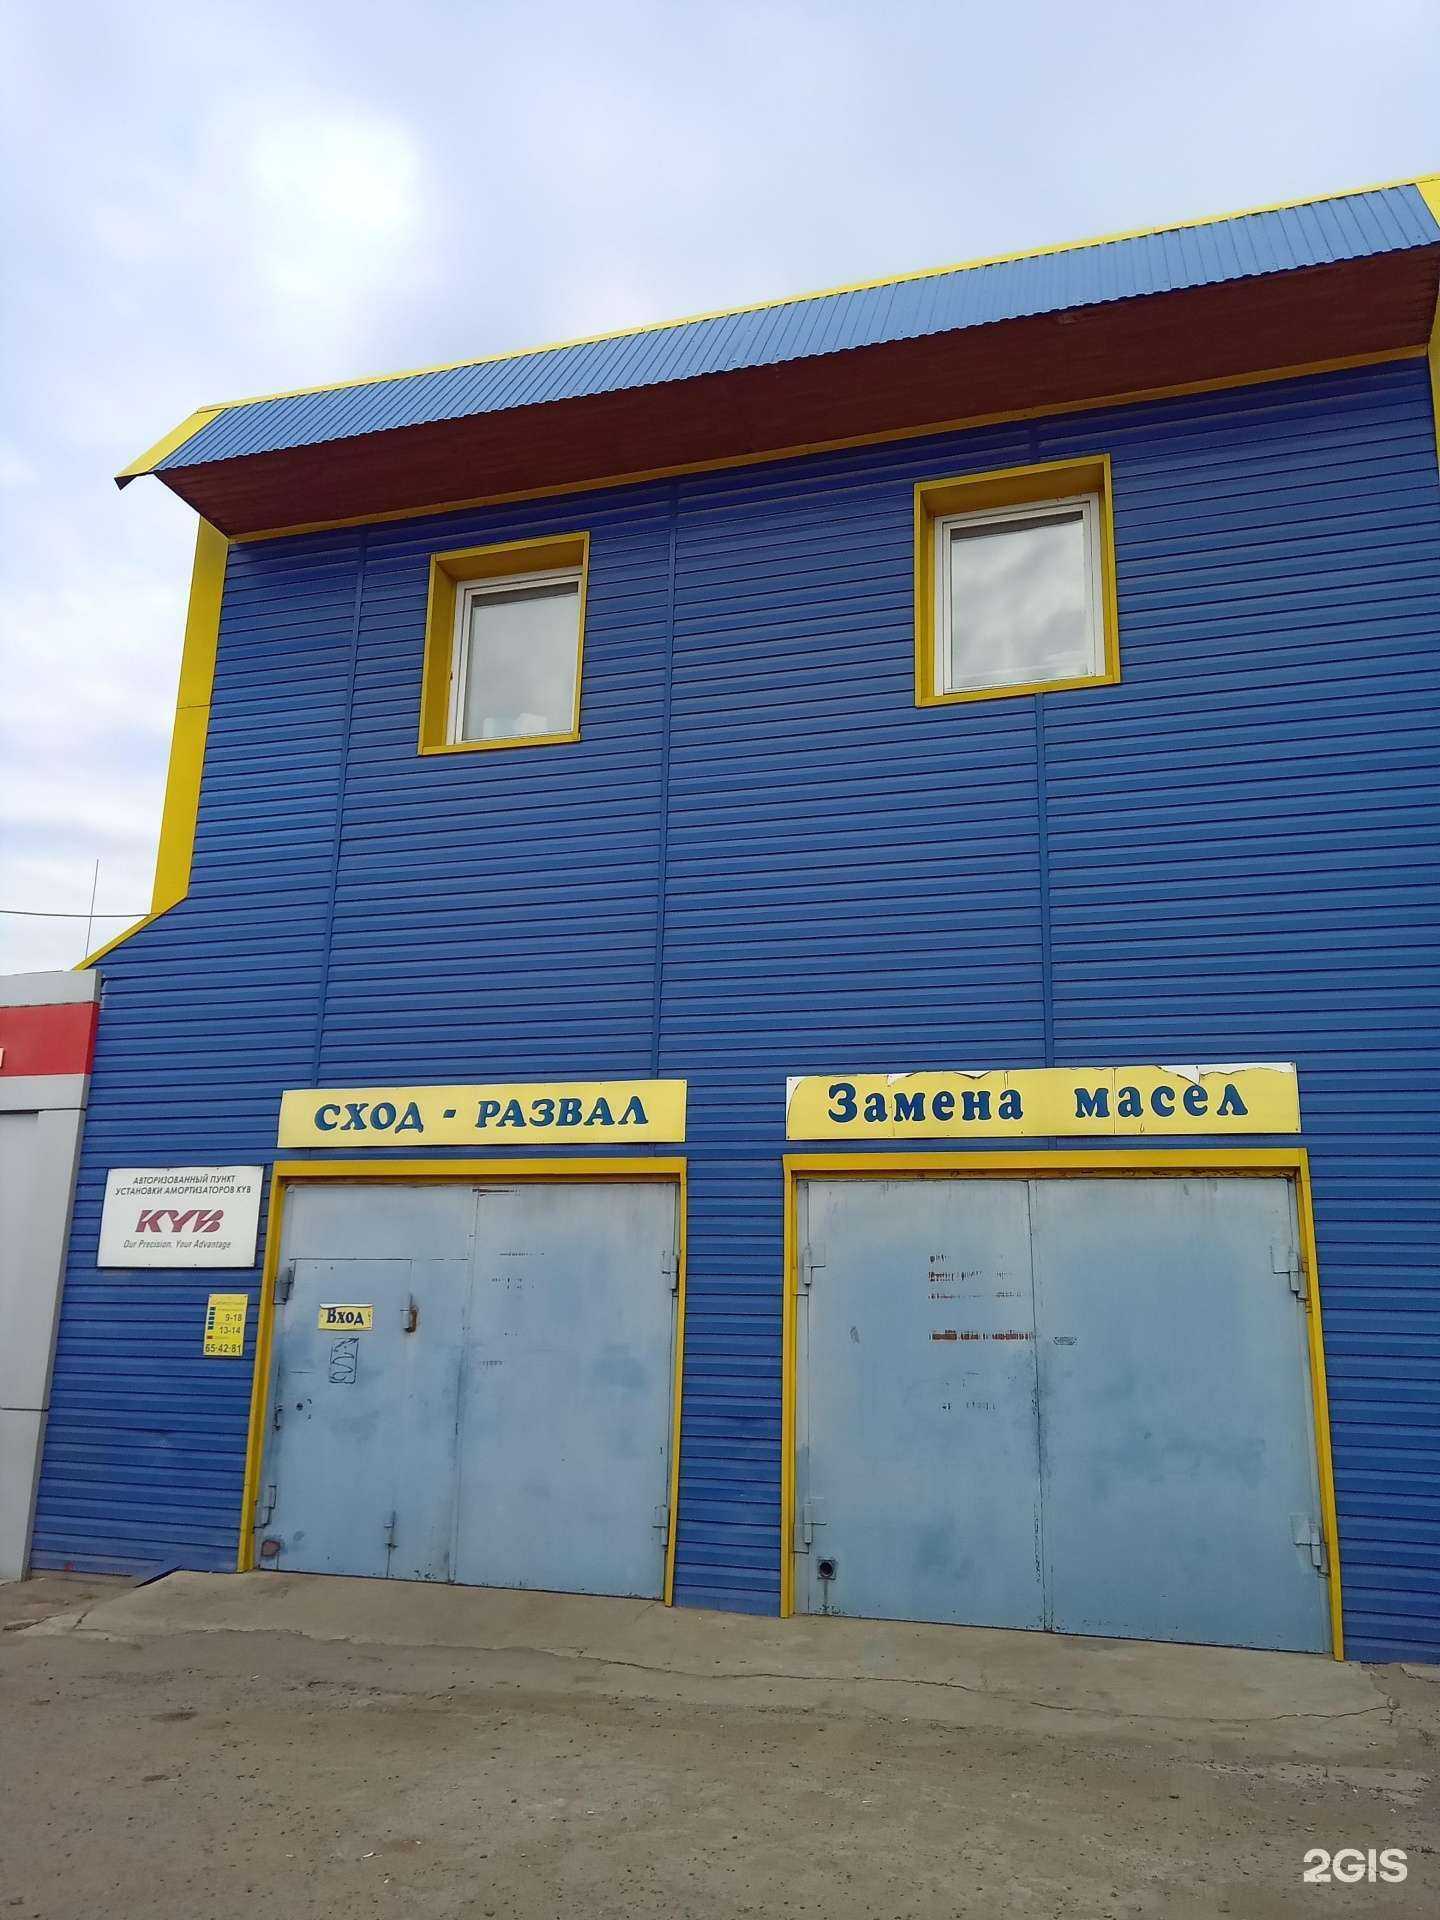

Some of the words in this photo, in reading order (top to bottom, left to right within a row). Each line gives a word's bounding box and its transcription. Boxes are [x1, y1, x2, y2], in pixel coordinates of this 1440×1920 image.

[828, 1083, 1023, 1123] Замена
[1074, 1084, 1248, 1119] масел
[314, 1101, 424, 1133] СХОД
[475, 1095, 649, 1128] РАЗВАЛ
[133, 1174, 208, 1185] АВТОРИЗОВАННЫЙ
[210, 1174, 236, 1184] ПУНКТ
[115, 1187, 163, 1196] УСТАНОВКИ
[164, 1186, 235, 1195] АМОРТИЗАТОРОВ
[135, 1209, 224, 1233] KYB
[123, 1239, 136, 1249] Our
[176, 1239, 192, 1249] Your
[193, 1239, 232, 1250] Advantage
[225, 1313, 242, 1322] 9-18
[326, 1308, 364, 1325] Вход
[219, 1326, 241, 1335] 13-14
